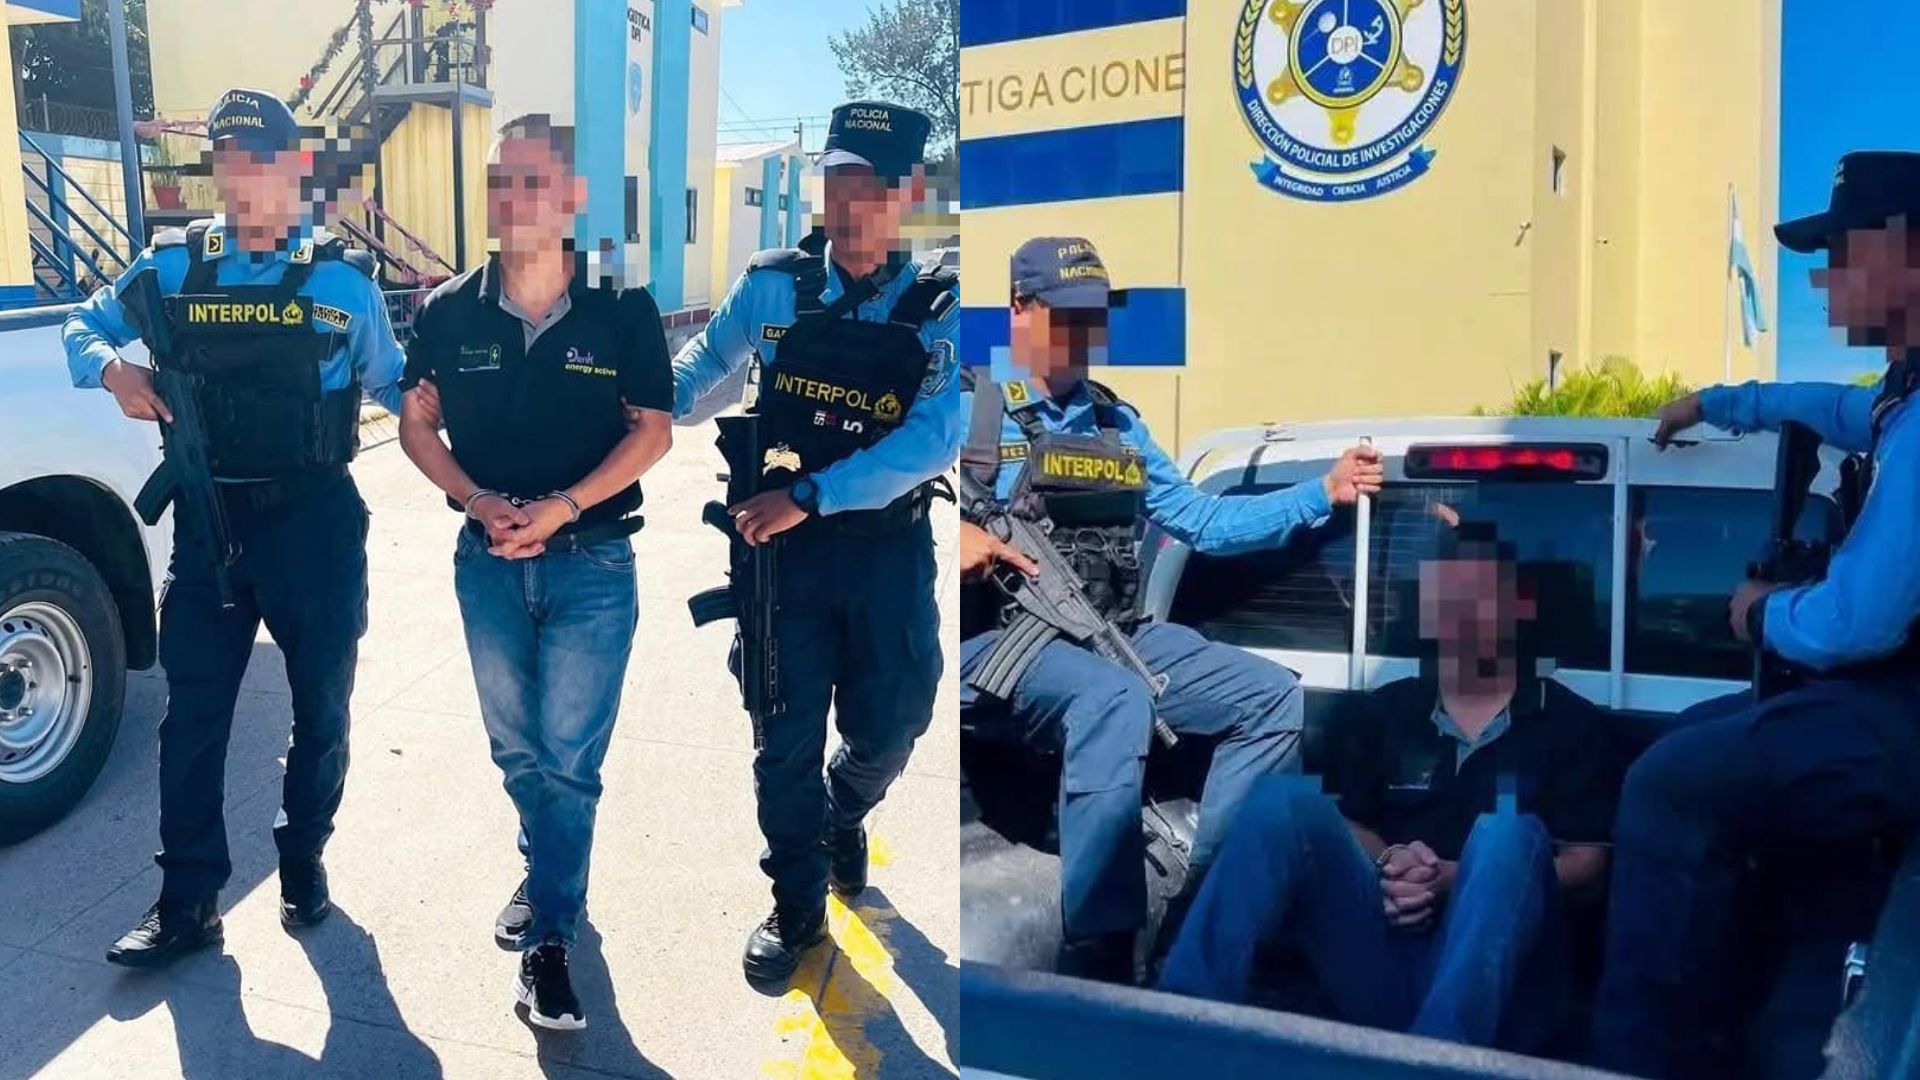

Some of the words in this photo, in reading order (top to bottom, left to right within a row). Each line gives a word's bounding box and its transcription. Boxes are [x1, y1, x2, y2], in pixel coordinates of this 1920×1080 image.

[1332, 35, 1358, 54] DPI
[961, 52, 1185, 115] TIGACIONE
[850, 108, 889, 120] POLICIA
[1290, 144, 1340, 168] POLICIAL
[1342, 152, 1359, 167] DE
[1360, 79, 1448, 162] INVESTIGACIONES
[845, 120, 893, 132] NACIONAL
[1332, 183, 1366, 195] CIENCIA
[188, 303, 280, 323] INTERPOL
[565, 363, 592, 374] energy
[594, 367, 618, 376] active
[775, 373, 872, 411] INTERPOL
[1044, 453, 1124, 481] INTERPOL
